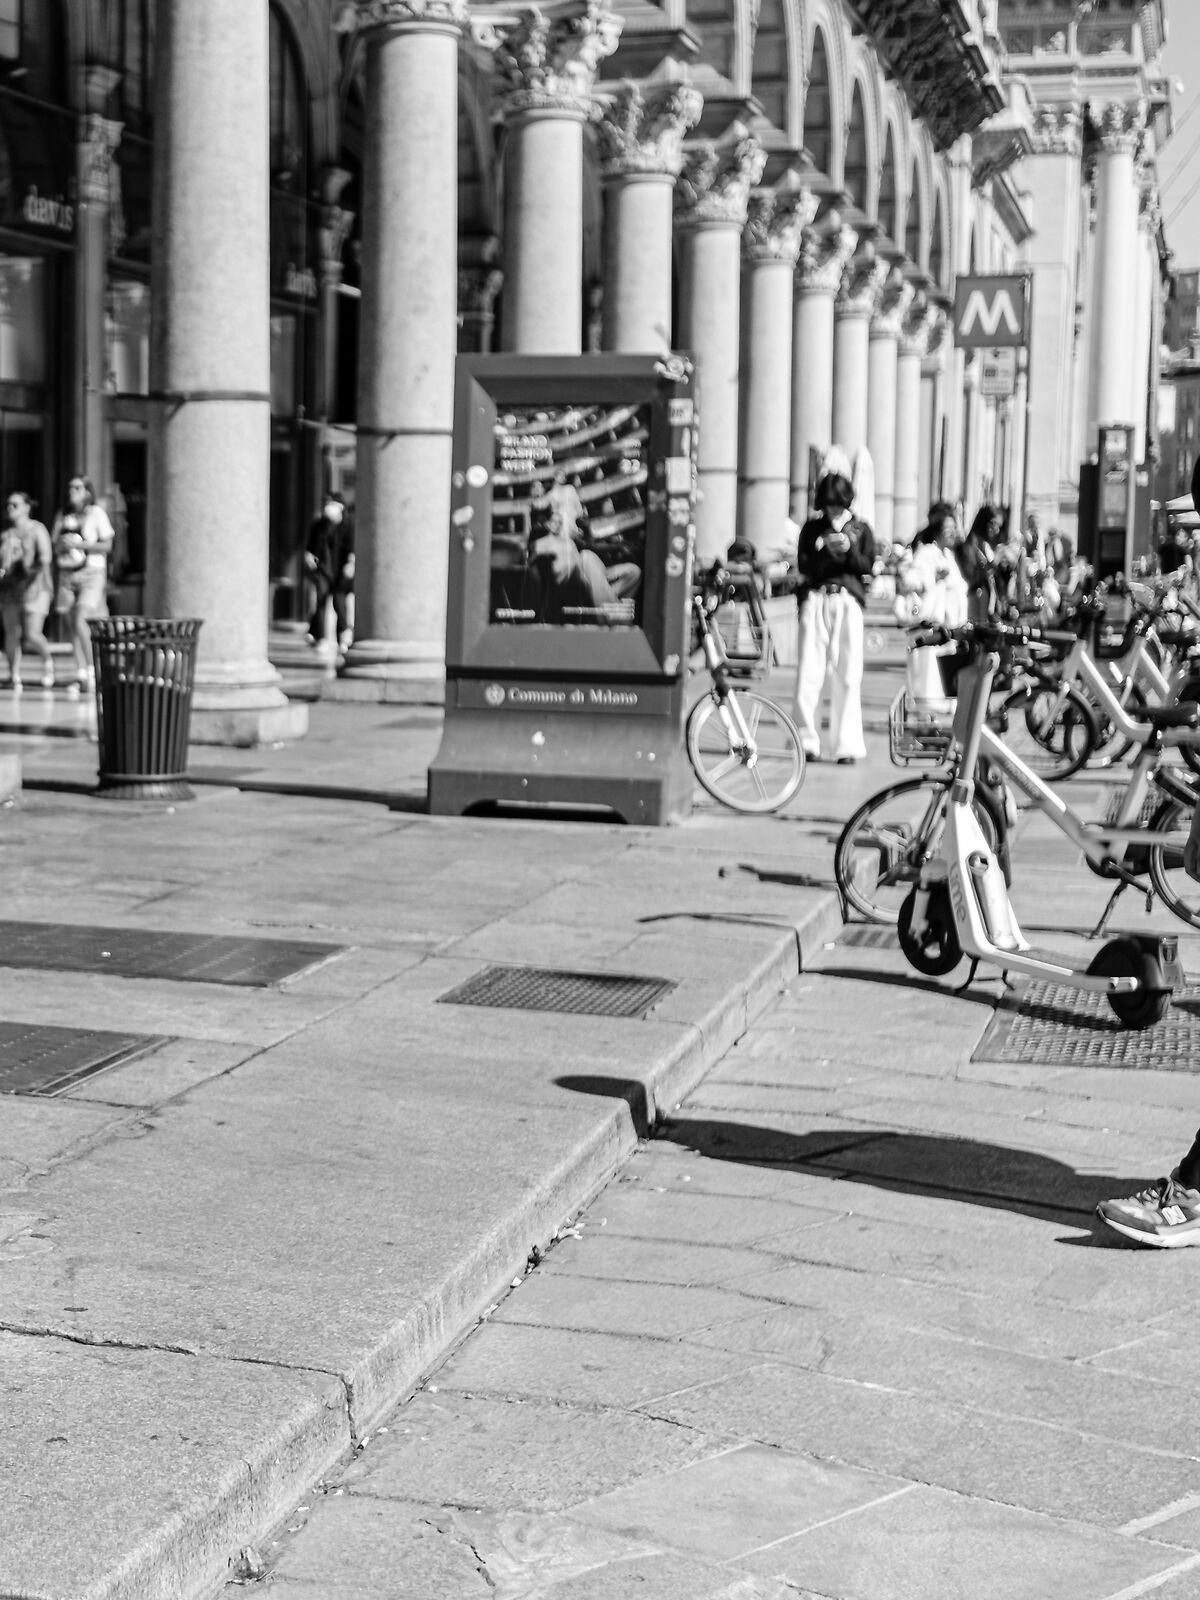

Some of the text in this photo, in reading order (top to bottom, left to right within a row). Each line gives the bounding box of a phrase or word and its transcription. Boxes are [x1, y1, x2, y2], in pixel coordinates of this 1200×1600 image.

[959, 290, 1021, 336] M
[501, 447, 553, 459] FASHION
[502, 459, 536, 471] WEEK
[508, 687, 638, 705] Comune di Milano
